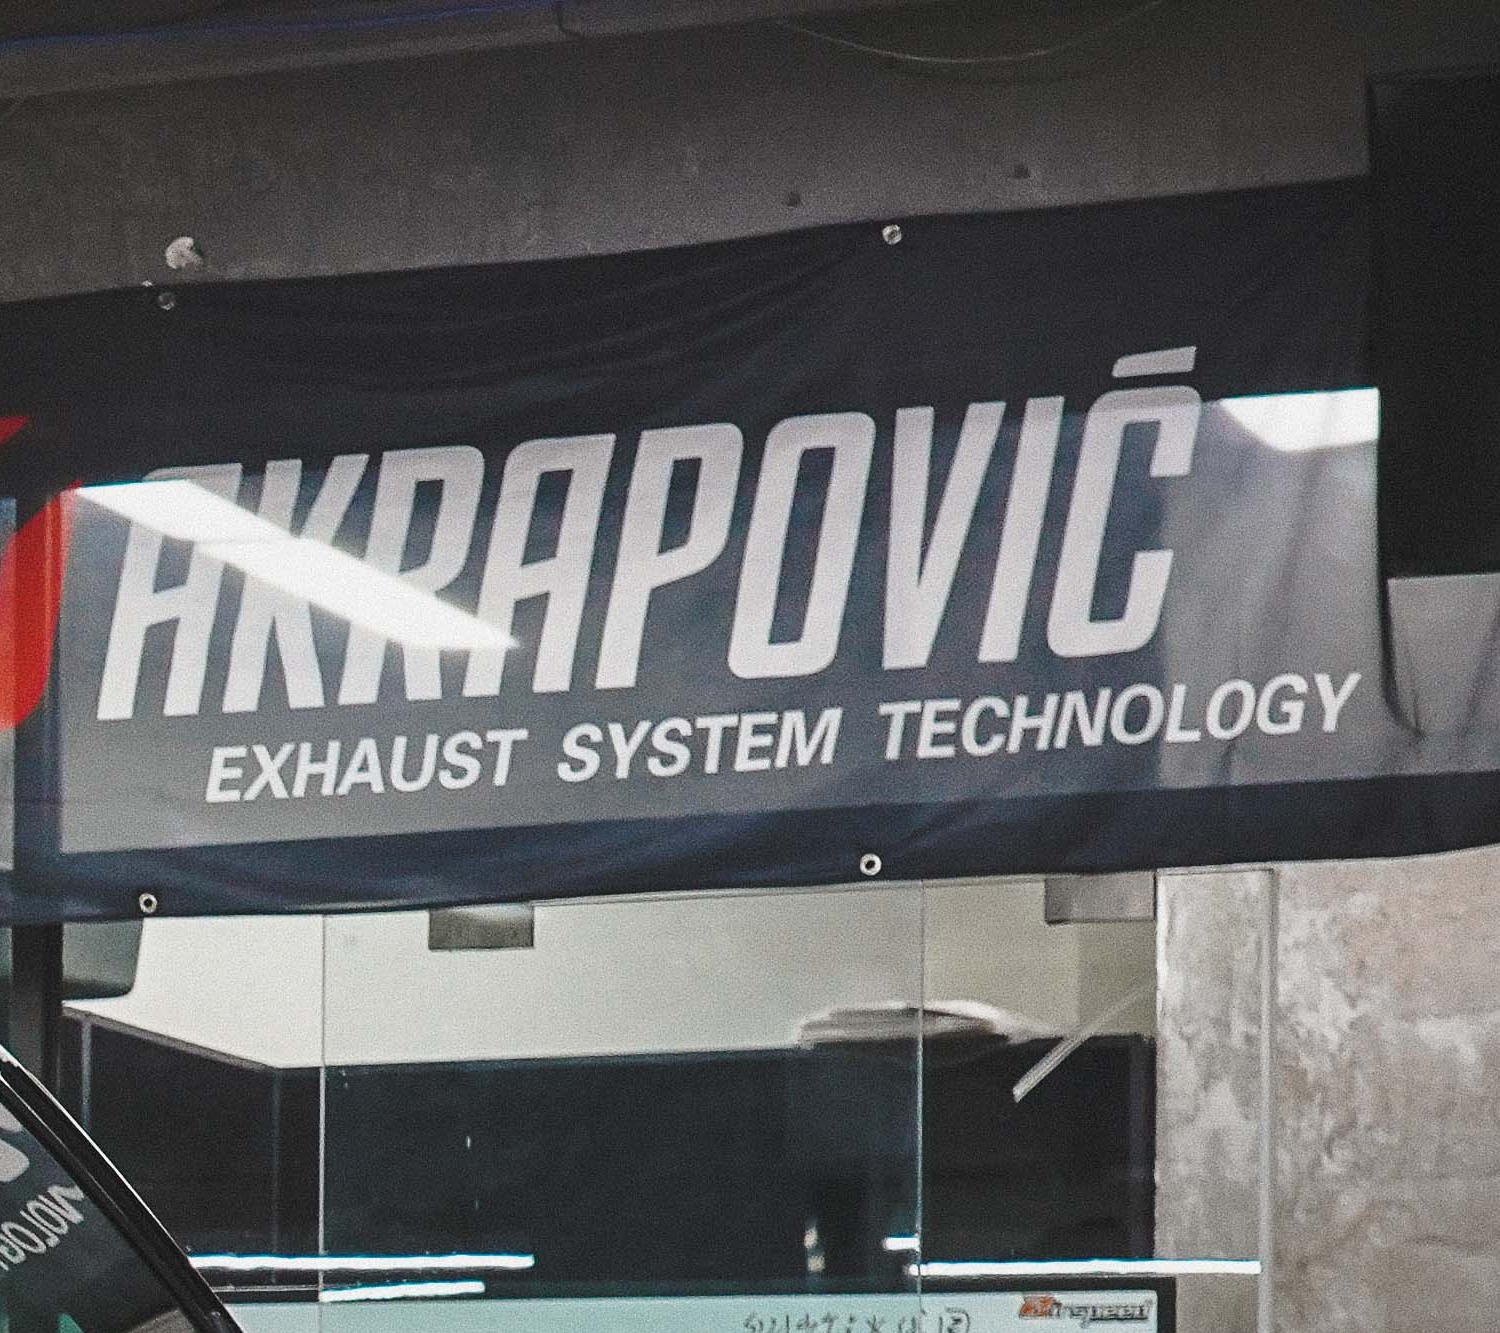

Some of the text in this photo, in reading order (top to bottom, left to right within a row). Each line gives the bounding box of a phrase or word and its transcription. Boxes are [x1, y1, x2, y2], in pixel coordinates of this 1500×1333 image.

[204, 672, 1363, 805] EXHAUST SYSTEM TECHNOLOGY
